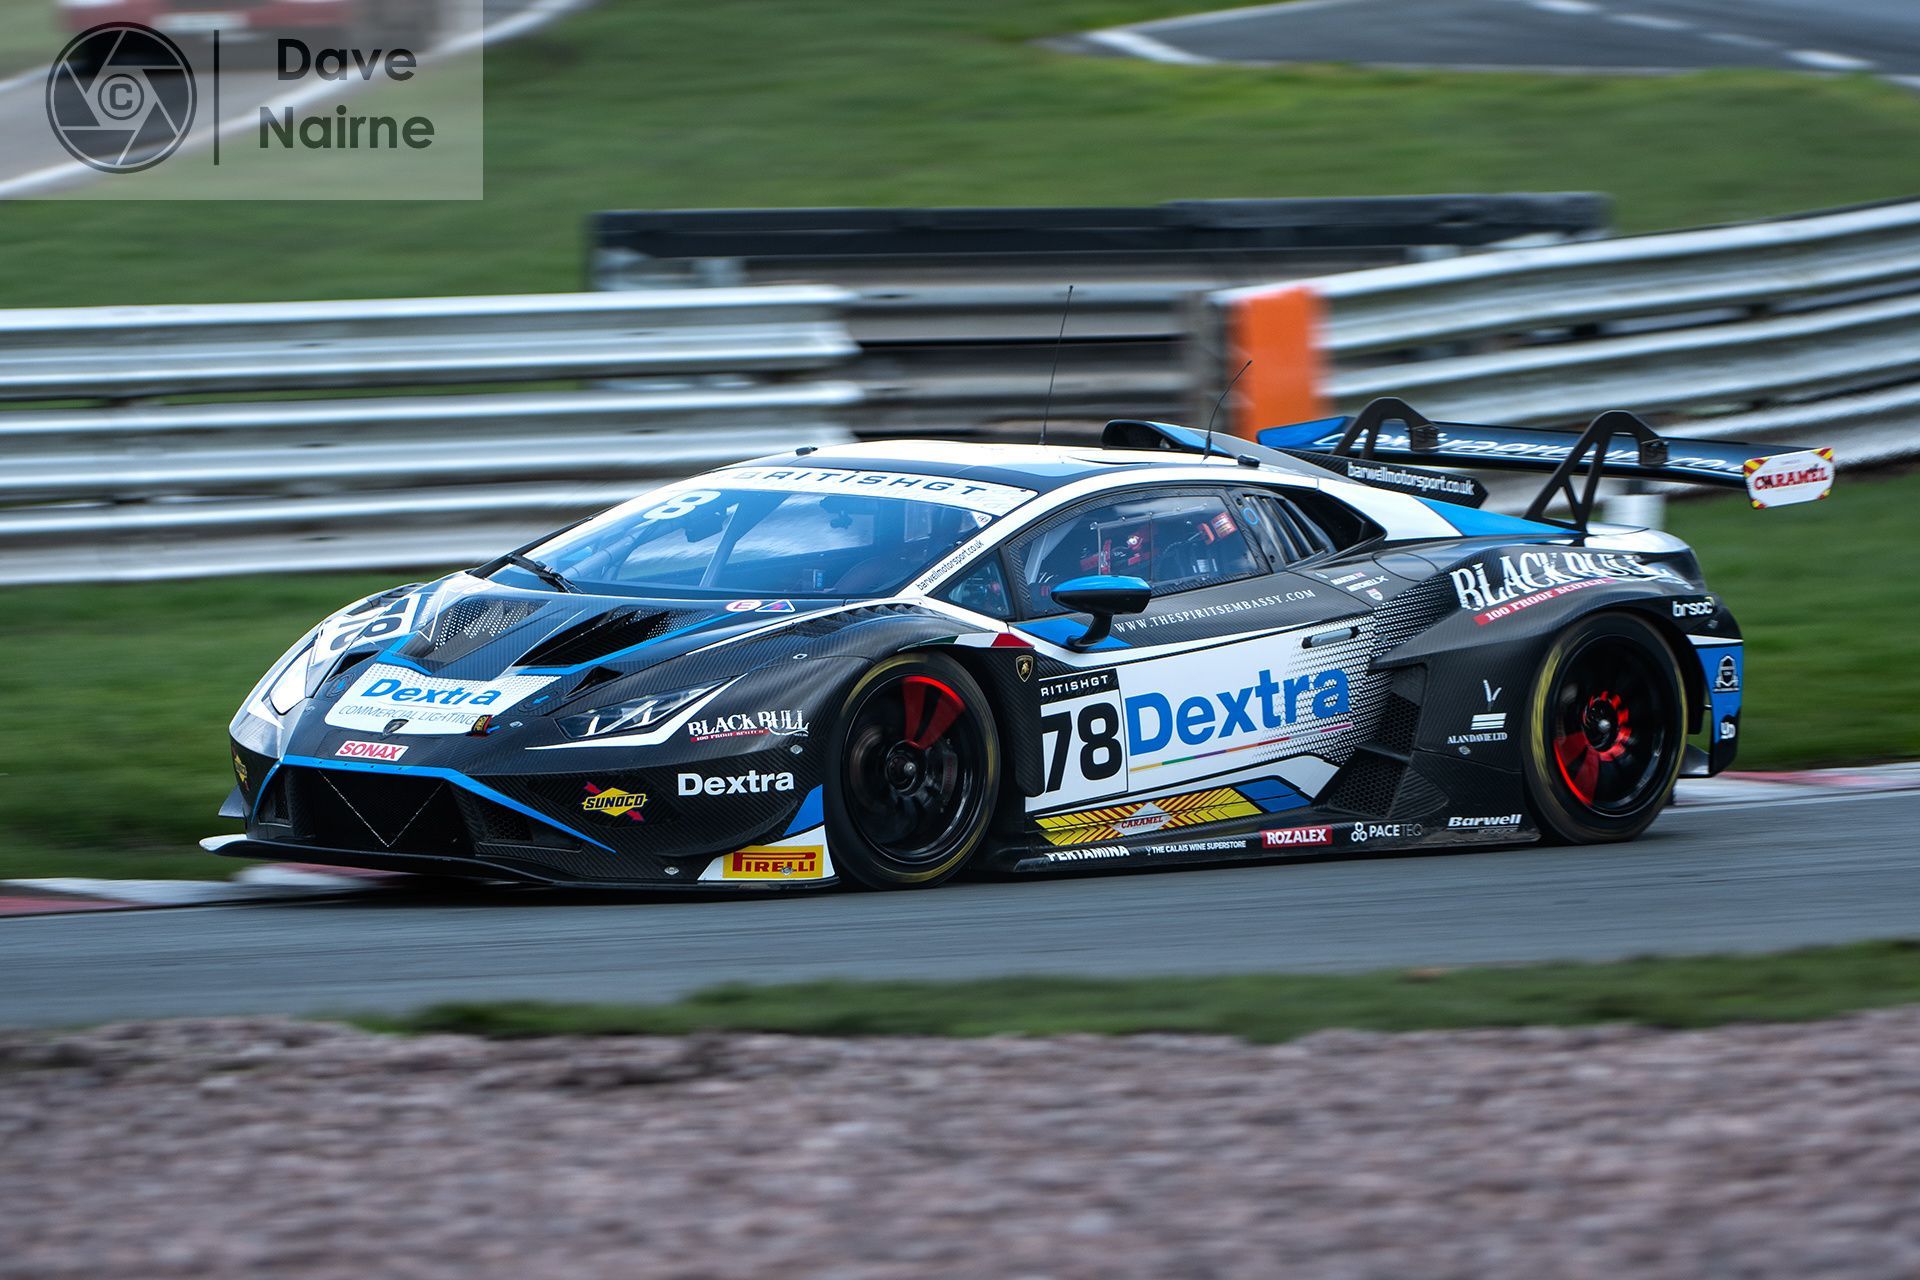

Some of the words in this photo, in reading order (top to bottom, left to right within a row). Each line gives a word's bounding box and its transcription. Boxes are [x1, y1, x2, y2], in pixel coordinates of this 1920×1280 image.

[915, 539, 985, 591] barwellmotorsport.co.uk
[1450, 552, 1583, 612] BLACK
[1114, 588, 1317, 633] WWW.THESPIRITSEMBASSY.COM
[1484, 607, 1510, 622] 100
[1511, 590, 1554, 609] PROOF
[1558, 578, 1608, 595] SCOTCH
[1672, 600, 1714, 617] brscc
[361, 678, 502, 705] Dextra
[1041, 675, 1109, 697] RITISHGT
[338, 705, 418, 721] COMMERCIAL
[419, 712, 481, 726] LIGHTING
[1124, 668, 1350, 756] Dextra
[687, 713, 757, 737] BLACK
[757, 710, 810, 736] BULL
[339, 742, 402, 760] SONAX
[1040, 702, 1123, 794] 78
[677, 770, 795, 796] Dextra
[585, 795, 645, 809] SUNOCO
[1120, 815, 1164, 829] CARAMEL
[1447, 814, 1522, 827] Barwell
[1165, 845, 1189, 853] CALAIS
[1189, 844, 1206, 852] WINE
[1206, 841, 1247, 851] SUPERSTORE
[1266, 828, 1327, 845] ROZALEX
[732, 851, 818, 873] PIRELLI
